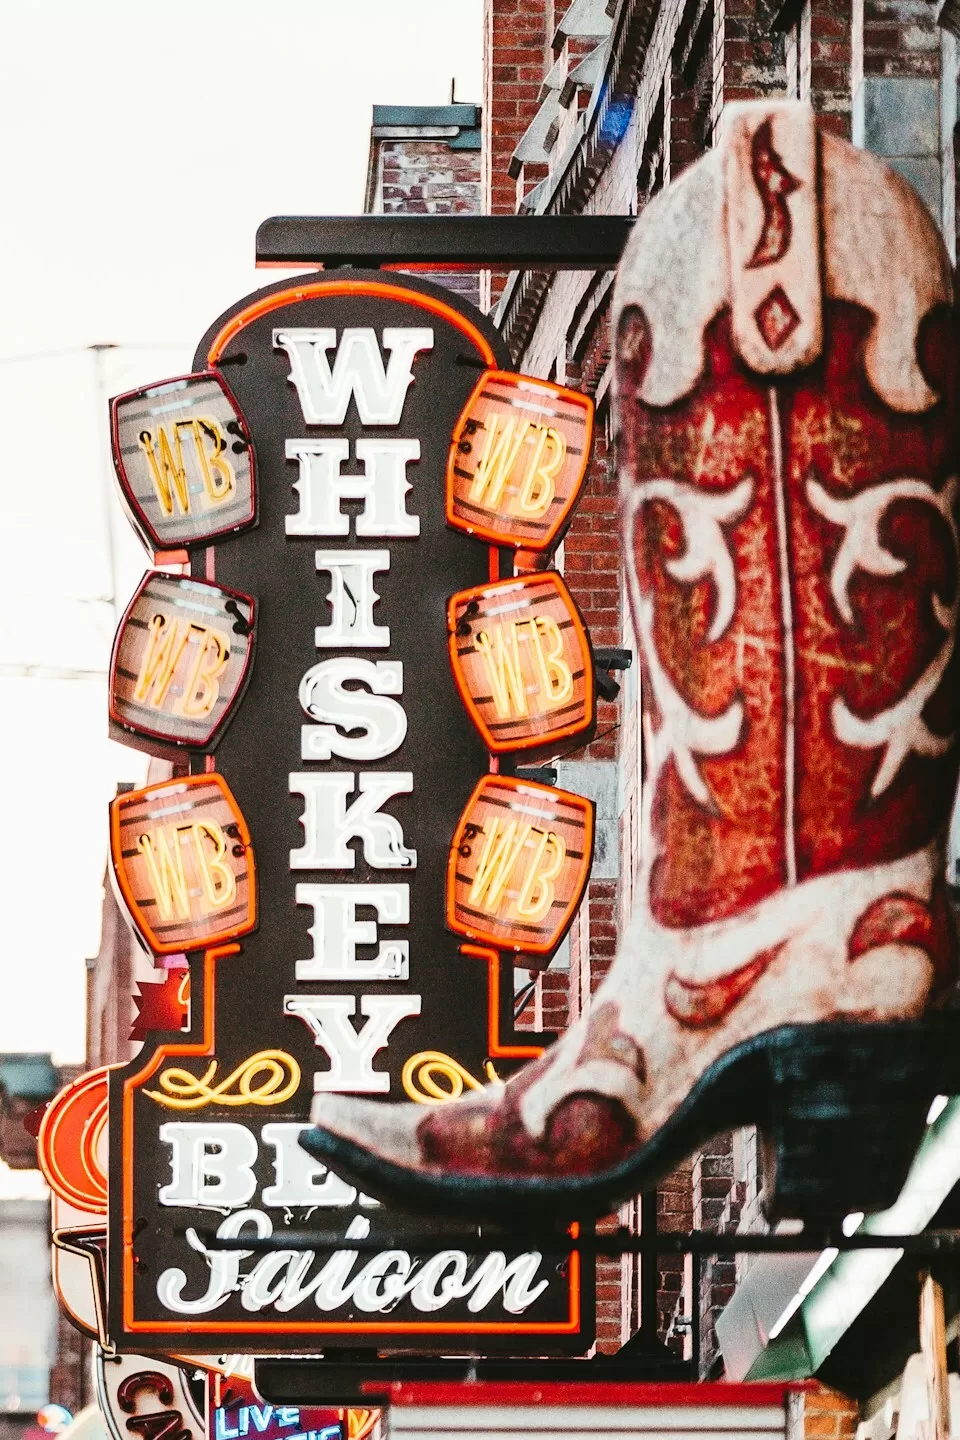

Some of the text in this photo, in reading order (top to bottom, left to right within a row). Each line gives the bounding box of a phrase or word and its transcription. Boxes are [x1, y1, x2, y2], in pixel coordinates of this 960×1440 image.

[138, 414, 237, 518] WB
[470, 411, 567, 520] WB
[132, 613, 232, 719] WB
[273, 328, 434, 1093] WHISKEY
[473, 614, 574, 718] WB
[137, 817, 239, 923] WB
[467, 814, 569, 923] WB
[156, 1209, 550, 1314] Saloon
